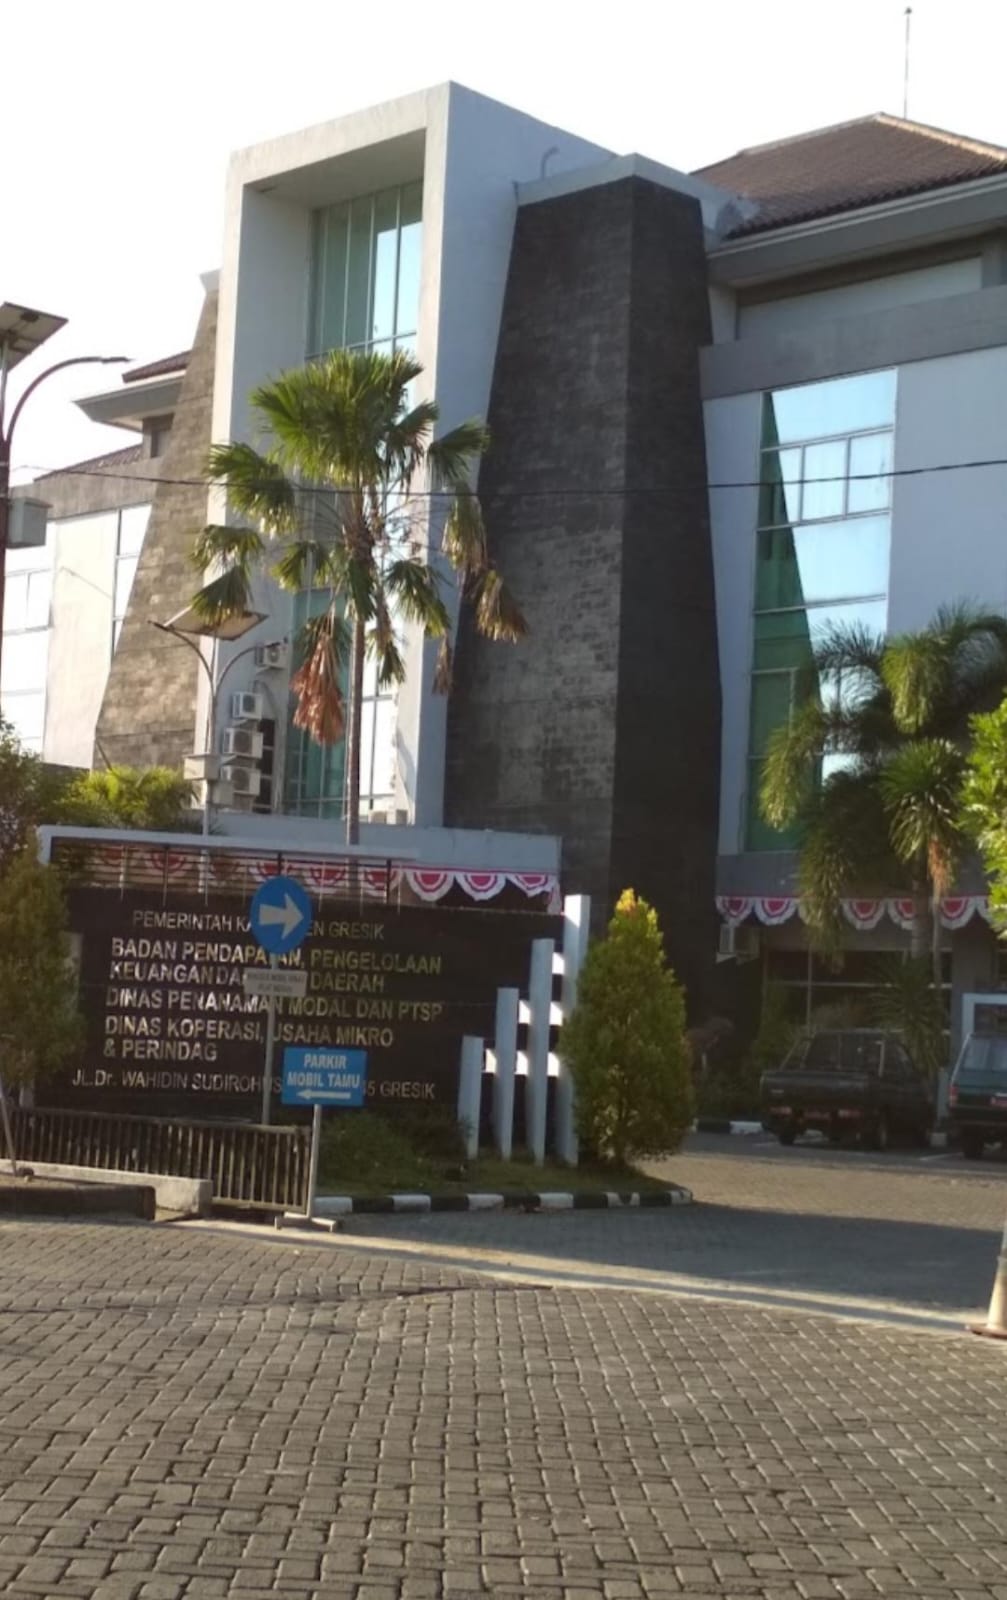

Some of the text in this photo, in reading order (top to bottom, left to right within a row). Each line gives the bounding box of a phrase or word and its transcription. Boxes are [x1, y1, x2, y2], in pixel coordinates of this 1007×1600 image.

[133, 910, 232, 931] PEMERINTAH
[329, 920, 384, 941] GRESIK
[111, 937, 442, 975] BADAN PENDAPAAN, PENGELOLAAN
[110, 961, 213, 984] KEUANGAN
[310, 971, 384, 993] DAERAH
[106, 988, 162, 1009] DINAS
[288, 997, 352, 1018] MODAL
[356, 1000, 393, 1020] DAN
[398, 1001, 443, 1023] PTSP
[105, 1015, 162, 1037] DINAS
[167, 1018, 264, 1043] KOPERASI,
[336, 1026, 394, 1048] MIKRO
[103, 1038, 218, 1061] & PERINDAG
[303, 1053, 347, 1070] PARKIR
[122, 1071, 188, 1089] WAHIDIN
[379, 1080, 436, 1100] GRESIK
[286, 1071, 324, 1088] MOBIL
[327, 1073, 361, 1089] TAMU
